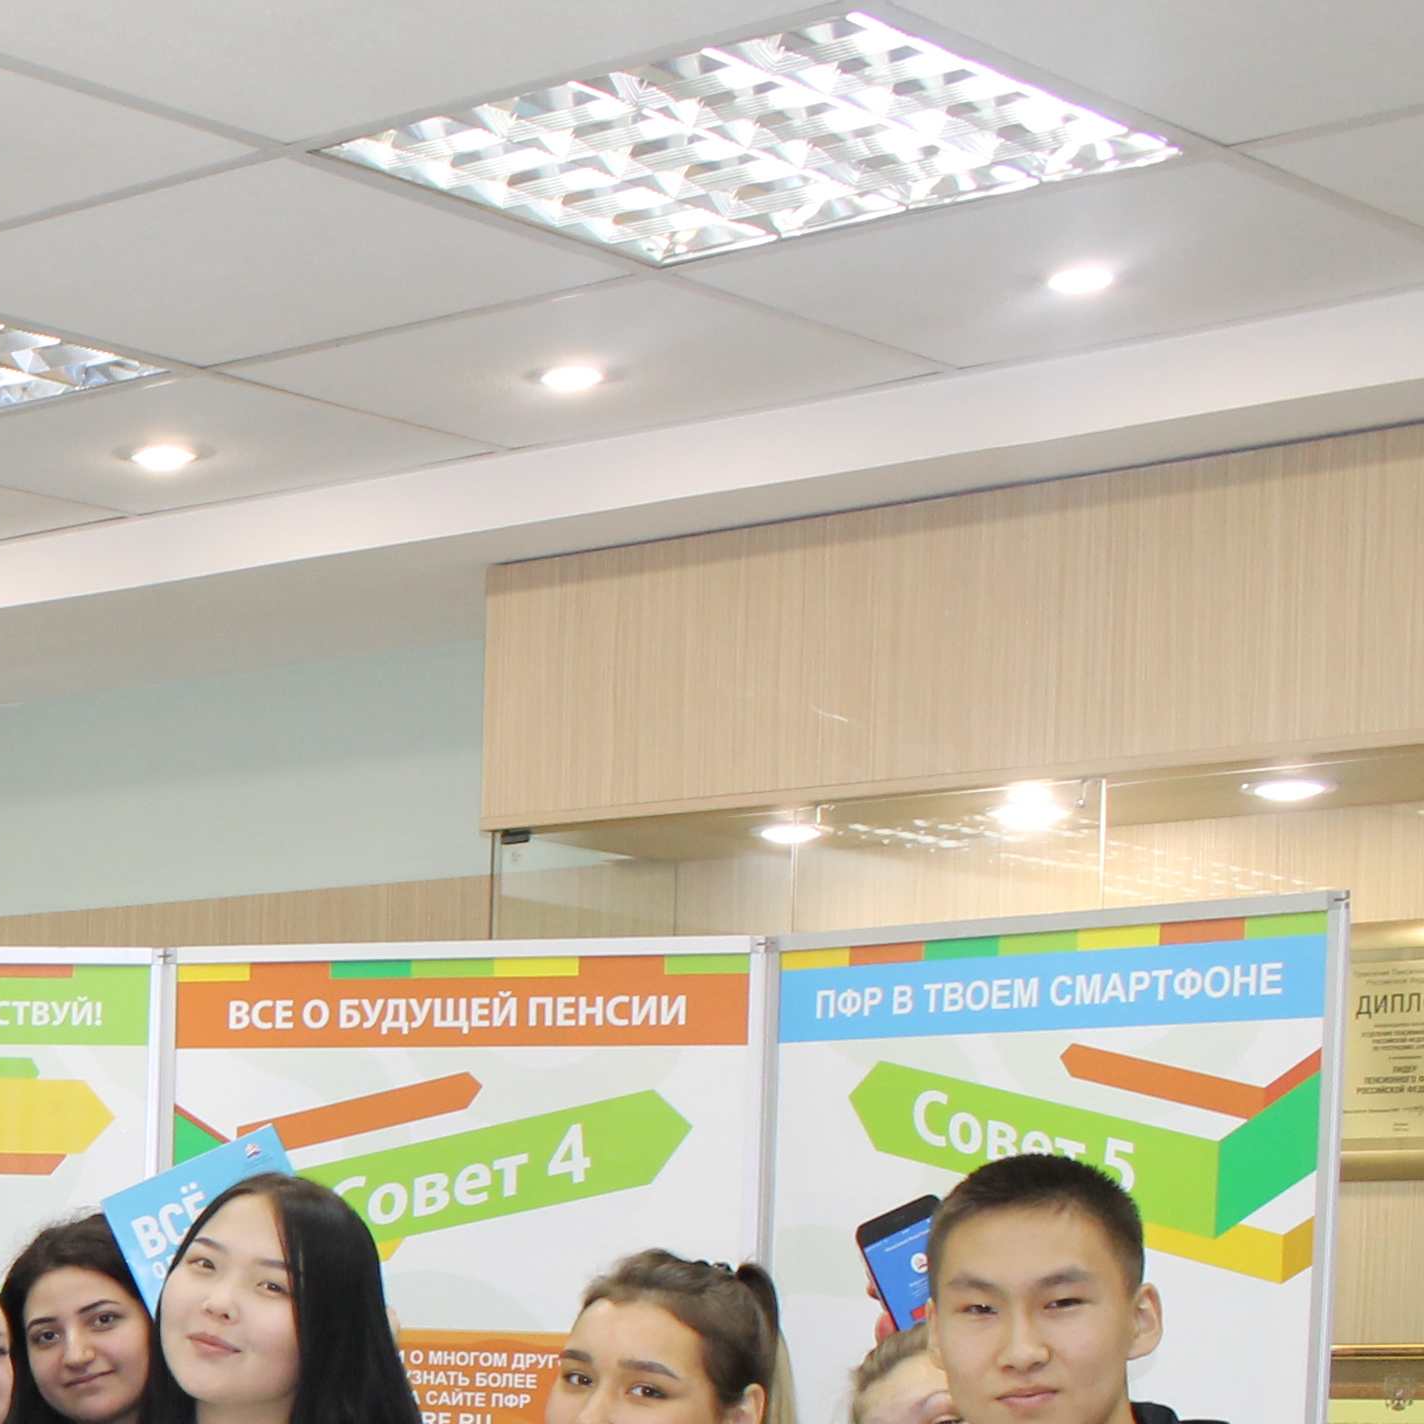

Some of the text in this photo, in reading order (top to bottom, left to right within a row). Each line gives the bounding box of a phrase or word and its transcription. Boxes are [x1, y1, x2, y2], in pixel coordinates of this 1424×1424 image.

[815, 963, 1282, 1020] ПФР В ТВОЕМ СМАРТФОНЕ
[1355, 993, 1424, 1019] ДИПЛ
[228, 990, 687, 1034] ВСЕ О БУДУЩЕЙ ПЕНСИИ
[548, 1124, 590, 1184] 4
[1104, 1139, 1134, 1192] 5
[409, 1351, 424, 1366] О
[428, 1351, 507, 1367] МНОГОМ
[475, 1373, 537, 1388] БОЛЕЕ
[426, 1388, 531, 1409] САЙТЕ ПФР
